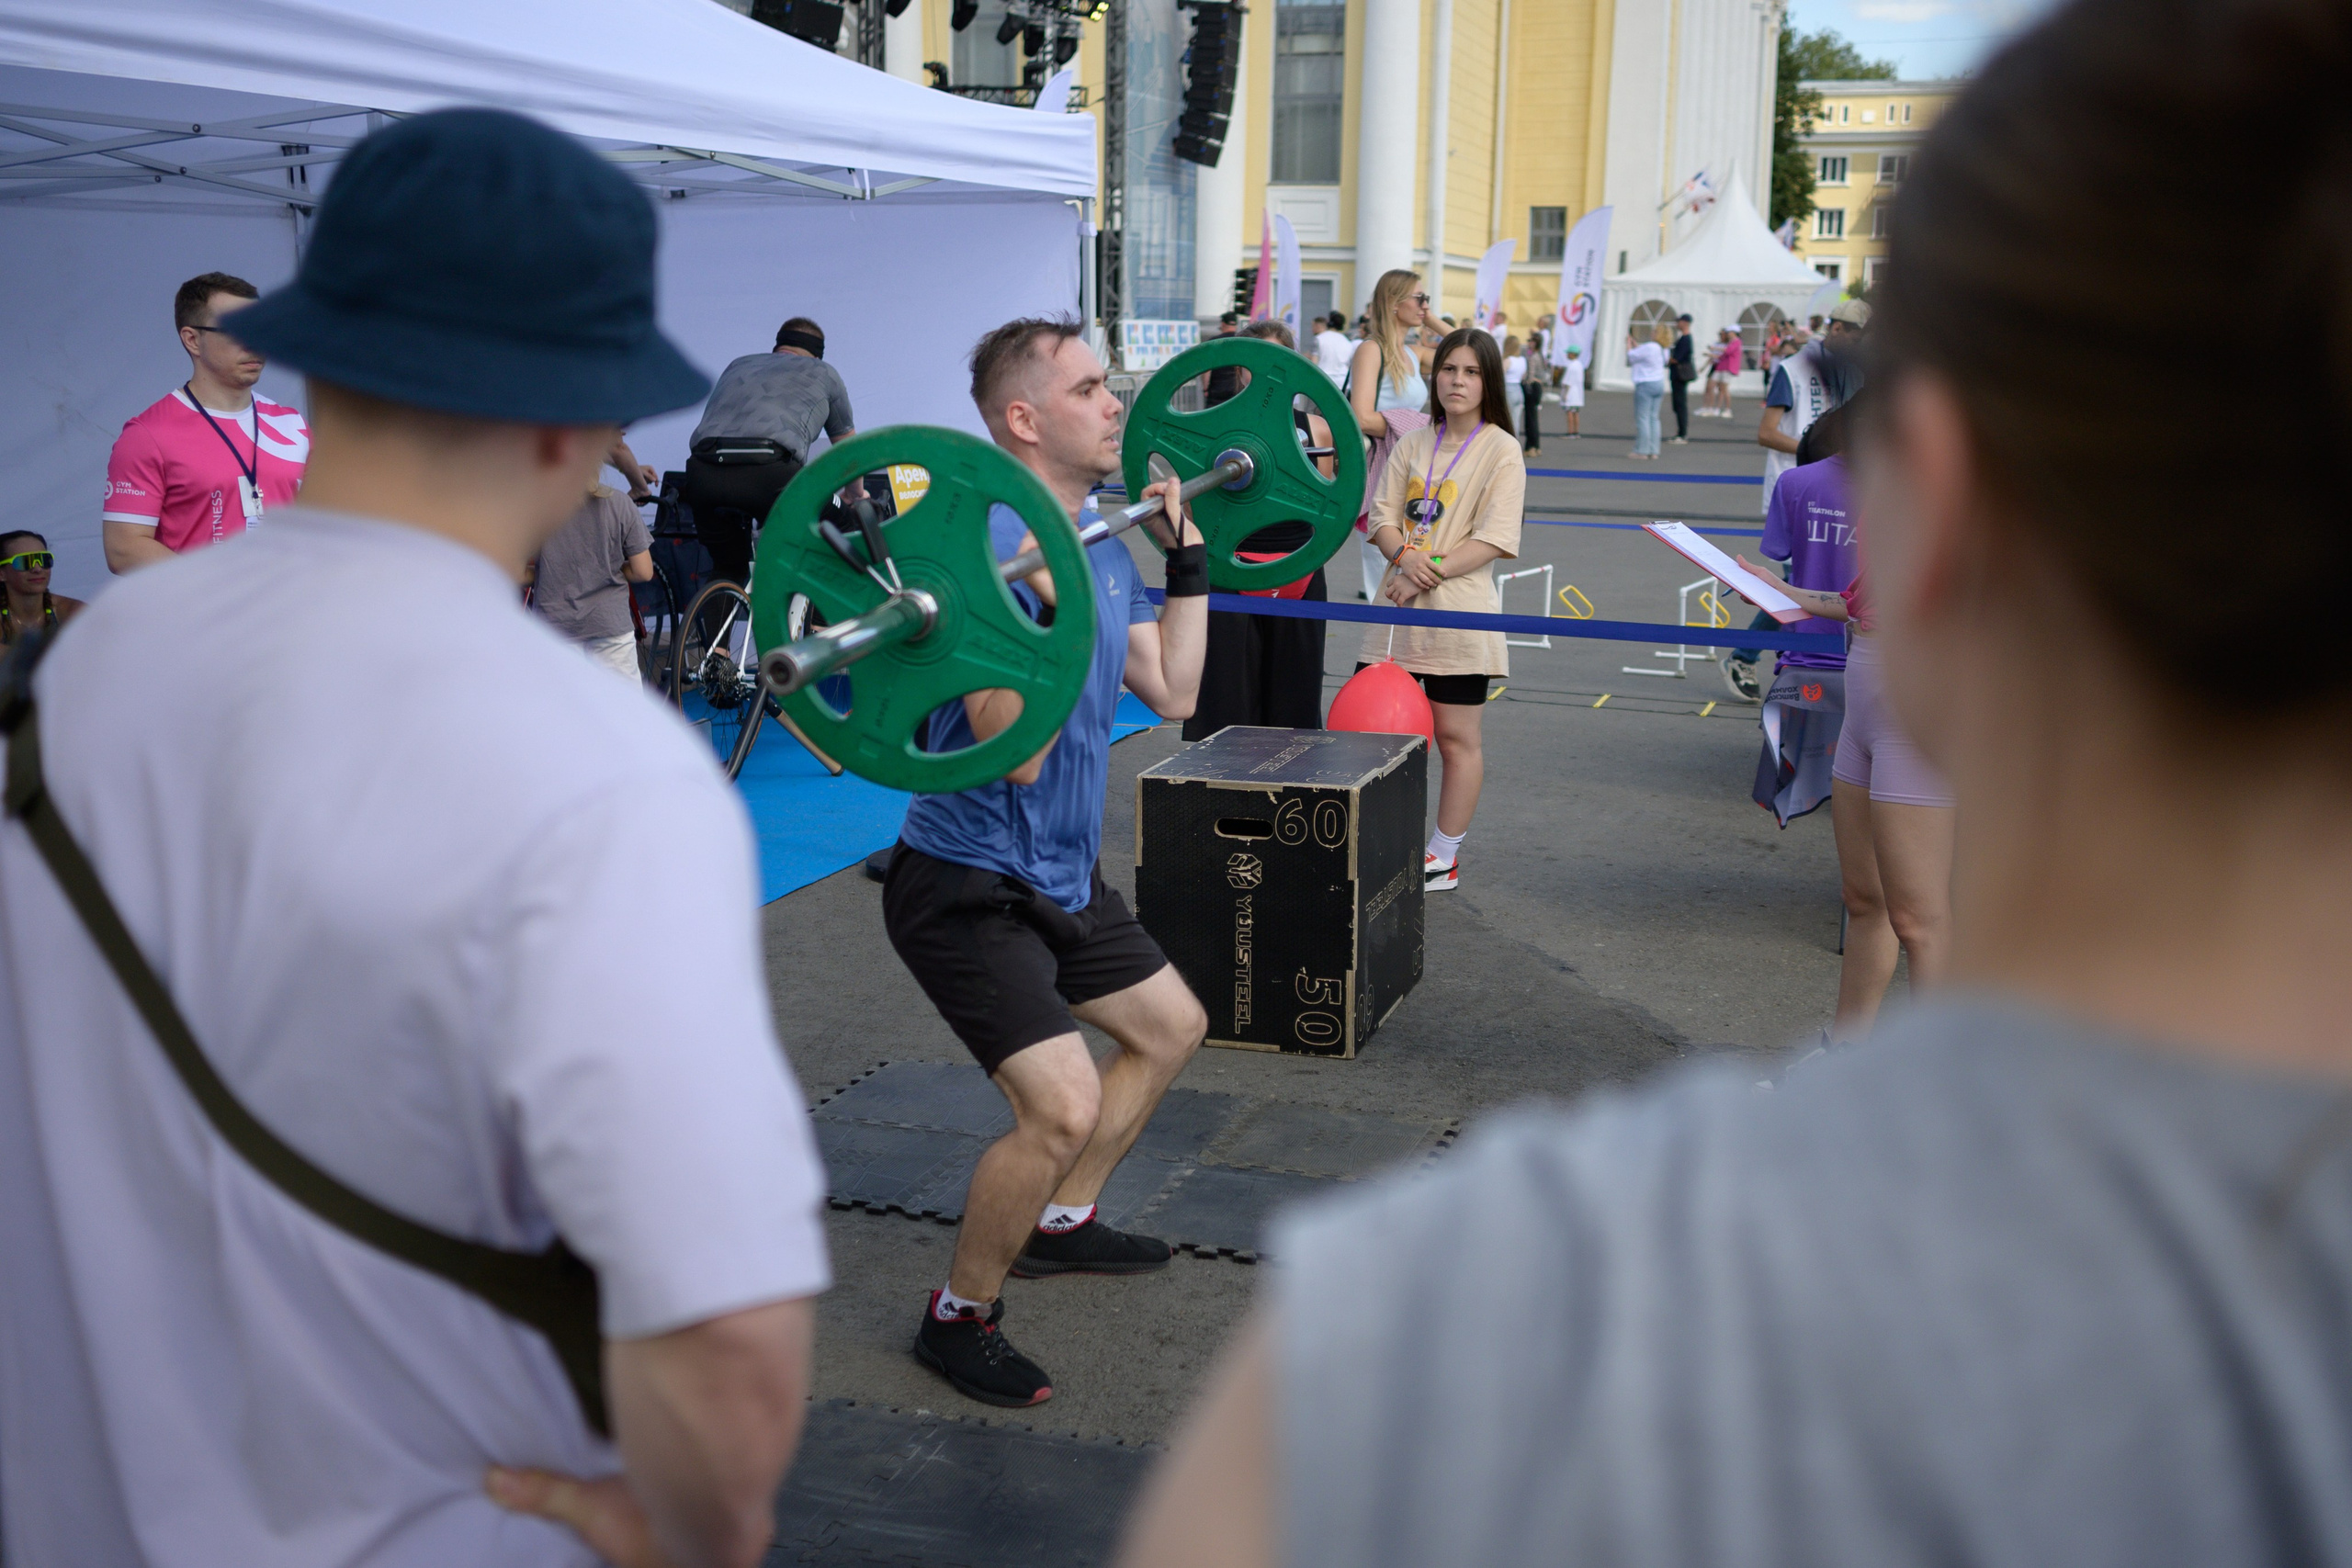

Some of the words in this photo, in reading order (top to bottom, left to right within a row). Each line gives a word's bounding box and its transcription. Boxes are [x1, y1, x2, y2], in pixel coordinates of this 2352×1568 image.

[1811, 377, 1821, 417] НТЕР
[116, 488, 145, 497] STATION
[211, 490, 223, 544] FITNESS
[1807, 520, 1858, 547] ШТА
[1275, 797, 1348, 848] 60
[1236, 895, 1252, 1034] YOUSTEEL
[1295, 974, 1342, 1046] 50
